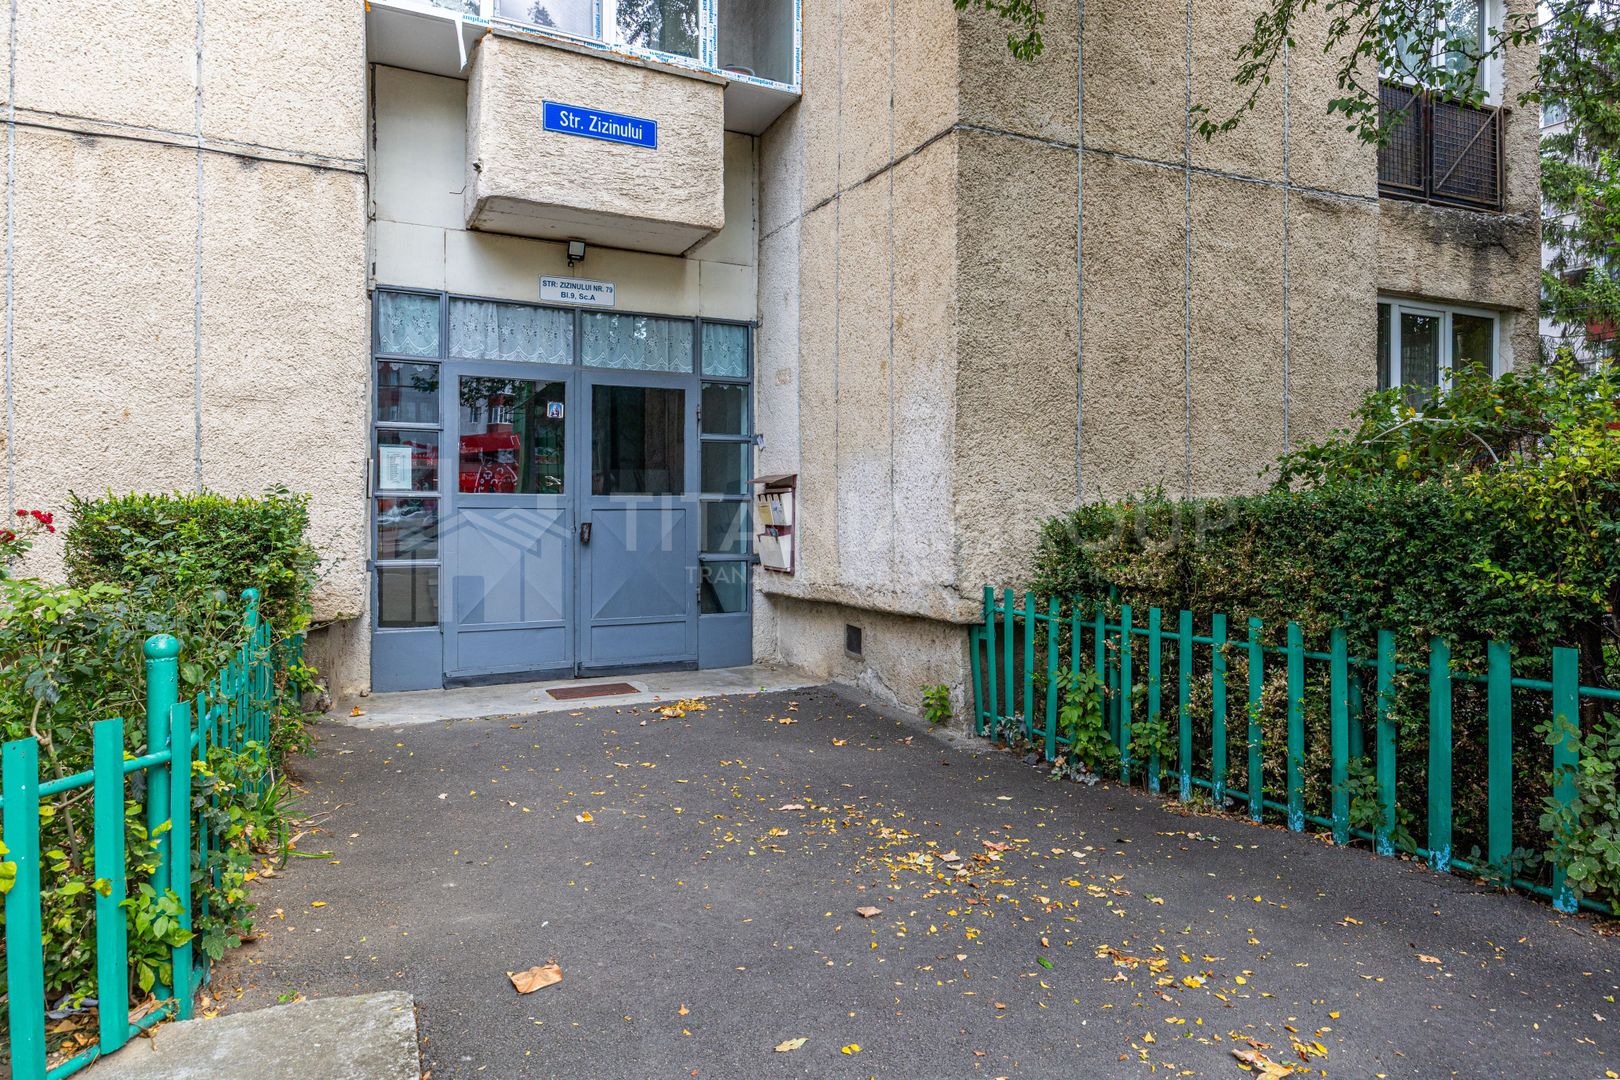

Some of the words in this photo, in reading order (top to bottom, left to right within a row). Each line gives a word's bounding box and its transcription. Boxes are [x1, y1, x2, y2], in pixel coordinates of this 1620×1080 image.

[748, 77, 774, 87] ramplast
[559, 110, 584, 130] Str.
[588, 115, 643, 140] Zizinului
[559, 281, 592, 291] ZIZINULUI
[593, 285, 605, 293] NR.
[606, 286, 613, 294] 79
[578, 293, 596, 301] Sc.A
